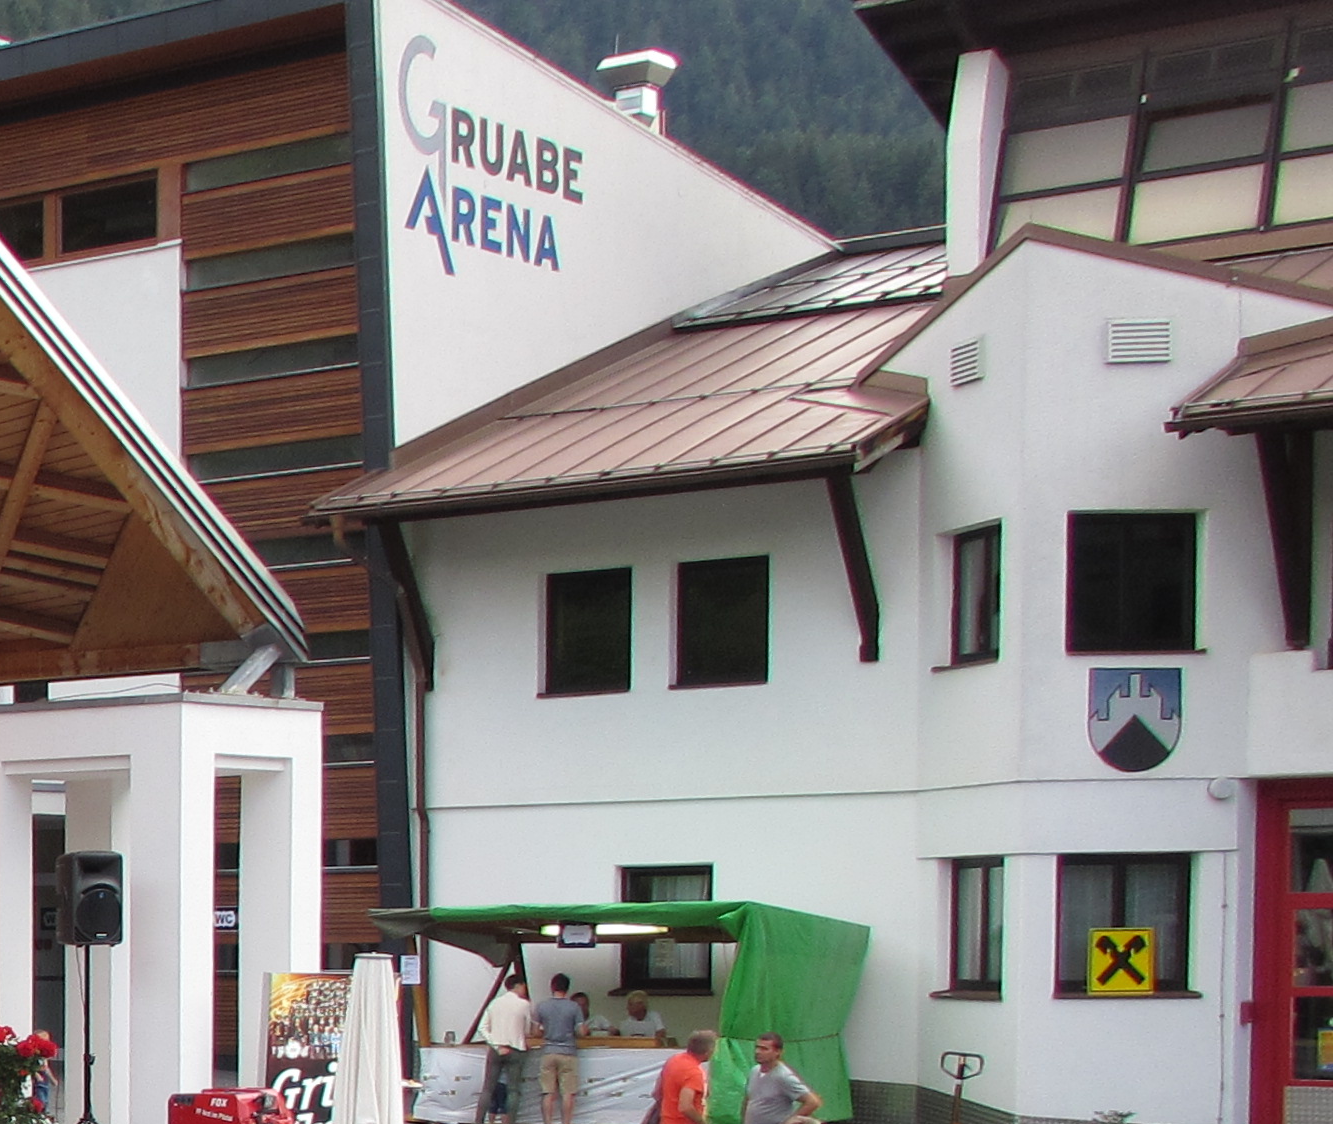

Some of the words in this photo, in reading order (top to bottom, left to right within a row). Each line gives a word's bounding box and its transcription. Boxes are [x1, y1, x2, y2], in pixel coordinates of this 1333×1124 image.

[397, 34, 584, 212] GRUABE
[405, 165, 560, 276] ARENA
[210, 1097, 229, 1108] FOX
